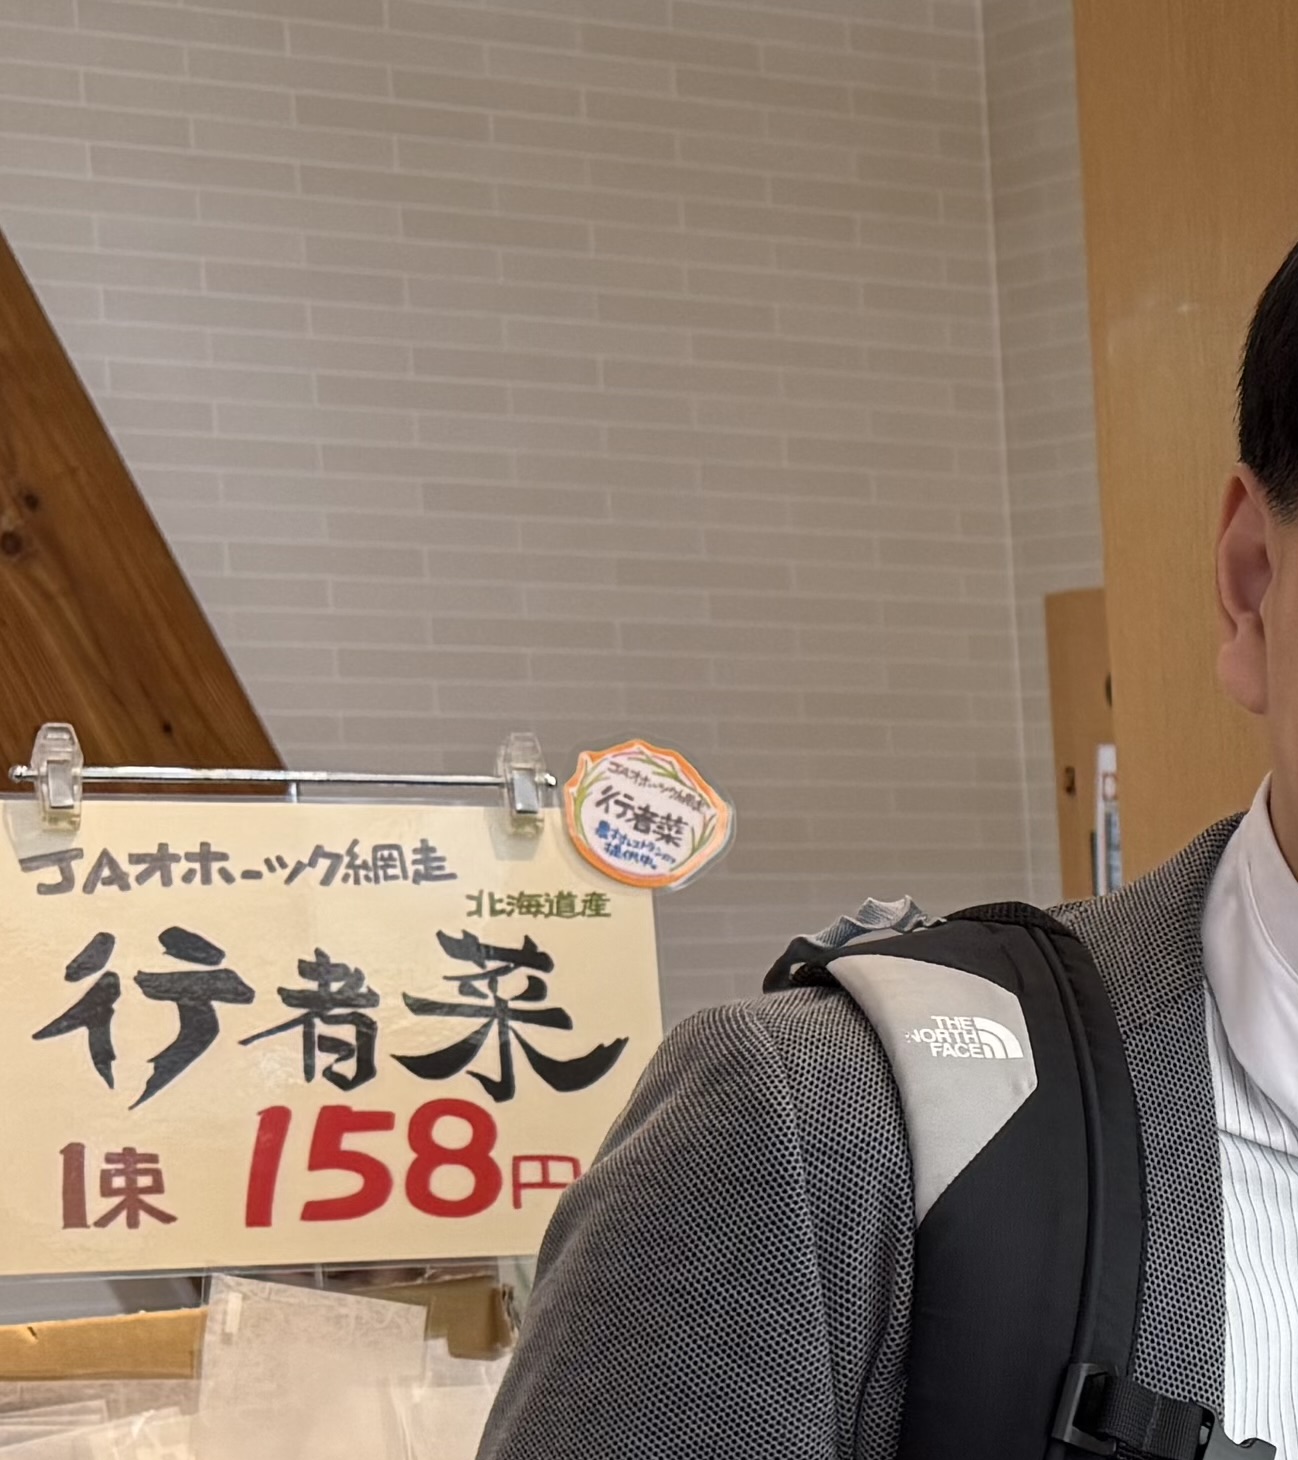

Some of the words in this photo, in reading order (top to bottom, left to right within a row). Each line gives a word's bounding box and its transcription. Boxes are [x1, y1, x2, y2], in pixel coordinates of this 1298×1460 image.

[595, 784, 689, 849] 行者菜
[20, 837, 457, 895] JAオホーツク網走
[466, 889, 612, 920] 北海道産
[32, 926, 629, 1110] 行者菜
[905, 1028, 979, 1046] NORTH
[931, 1015, 975, 1031] THE
[929, 1041, 986, 1059] FACE
[59, 1143, 178, 1231] 1束
